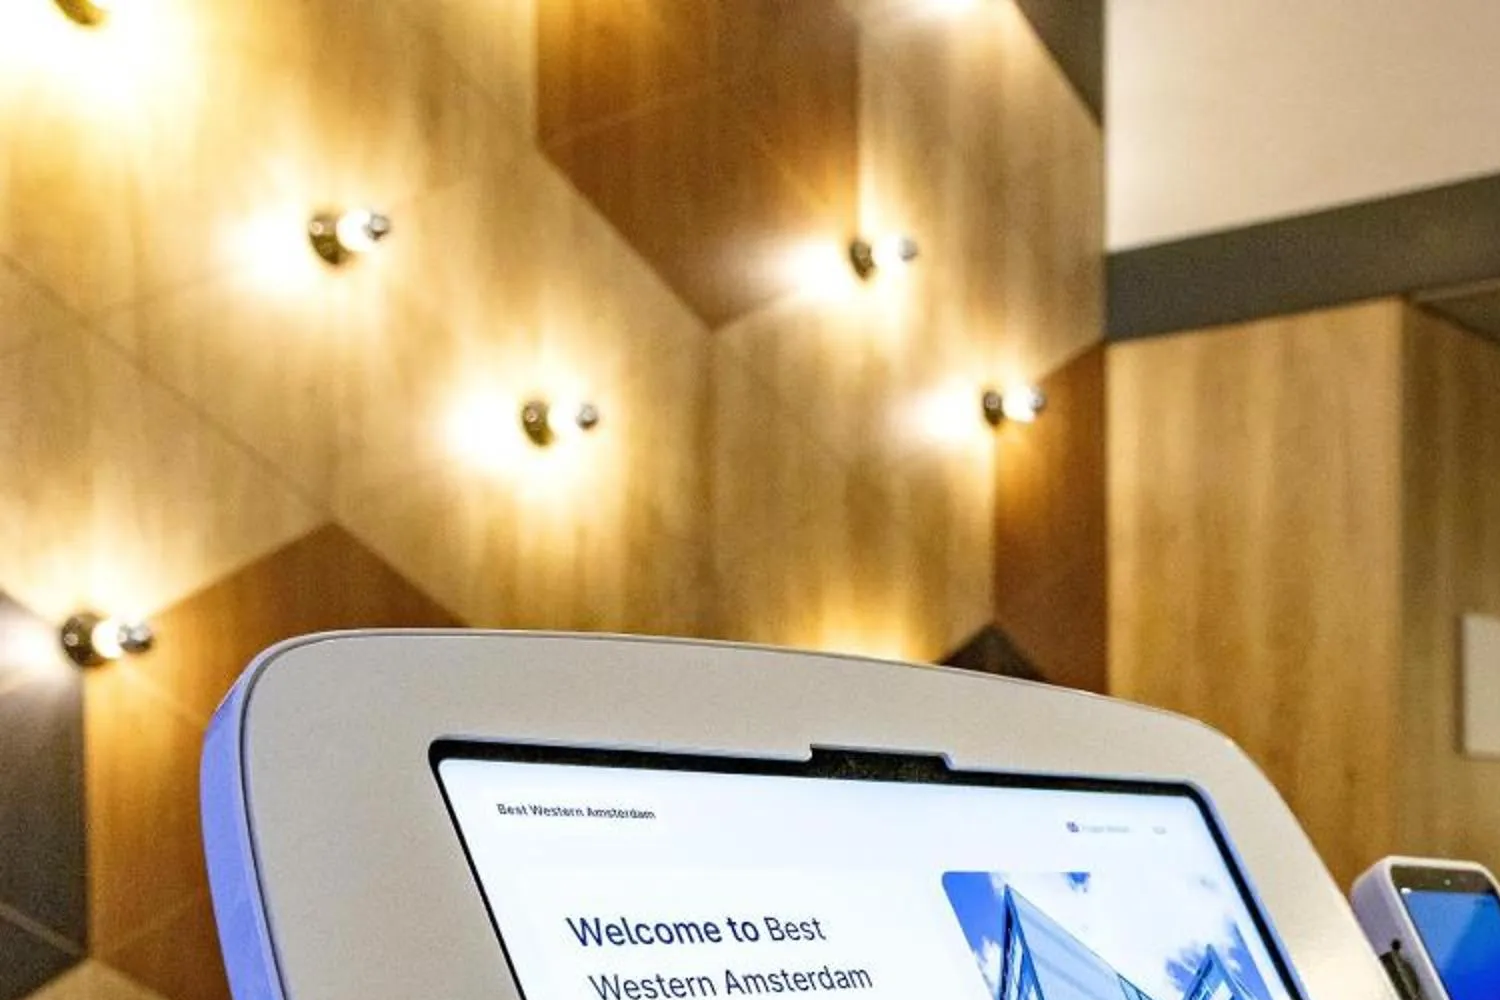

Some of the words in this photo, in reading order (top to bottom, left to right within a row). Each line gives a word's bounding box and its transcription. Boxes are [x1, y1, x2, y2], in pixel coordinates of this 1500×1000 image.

[496, 803, 528, 816] Best
[528, 803, 584, 817] Western
[587, 806, 656, 819] Amsterdam
[566, 916, 722, 947] Welcome
[727, 917, 760, 942] to
[763, 916, 826, 941] Best
[724, 965, 873, 995] Amsterdam
